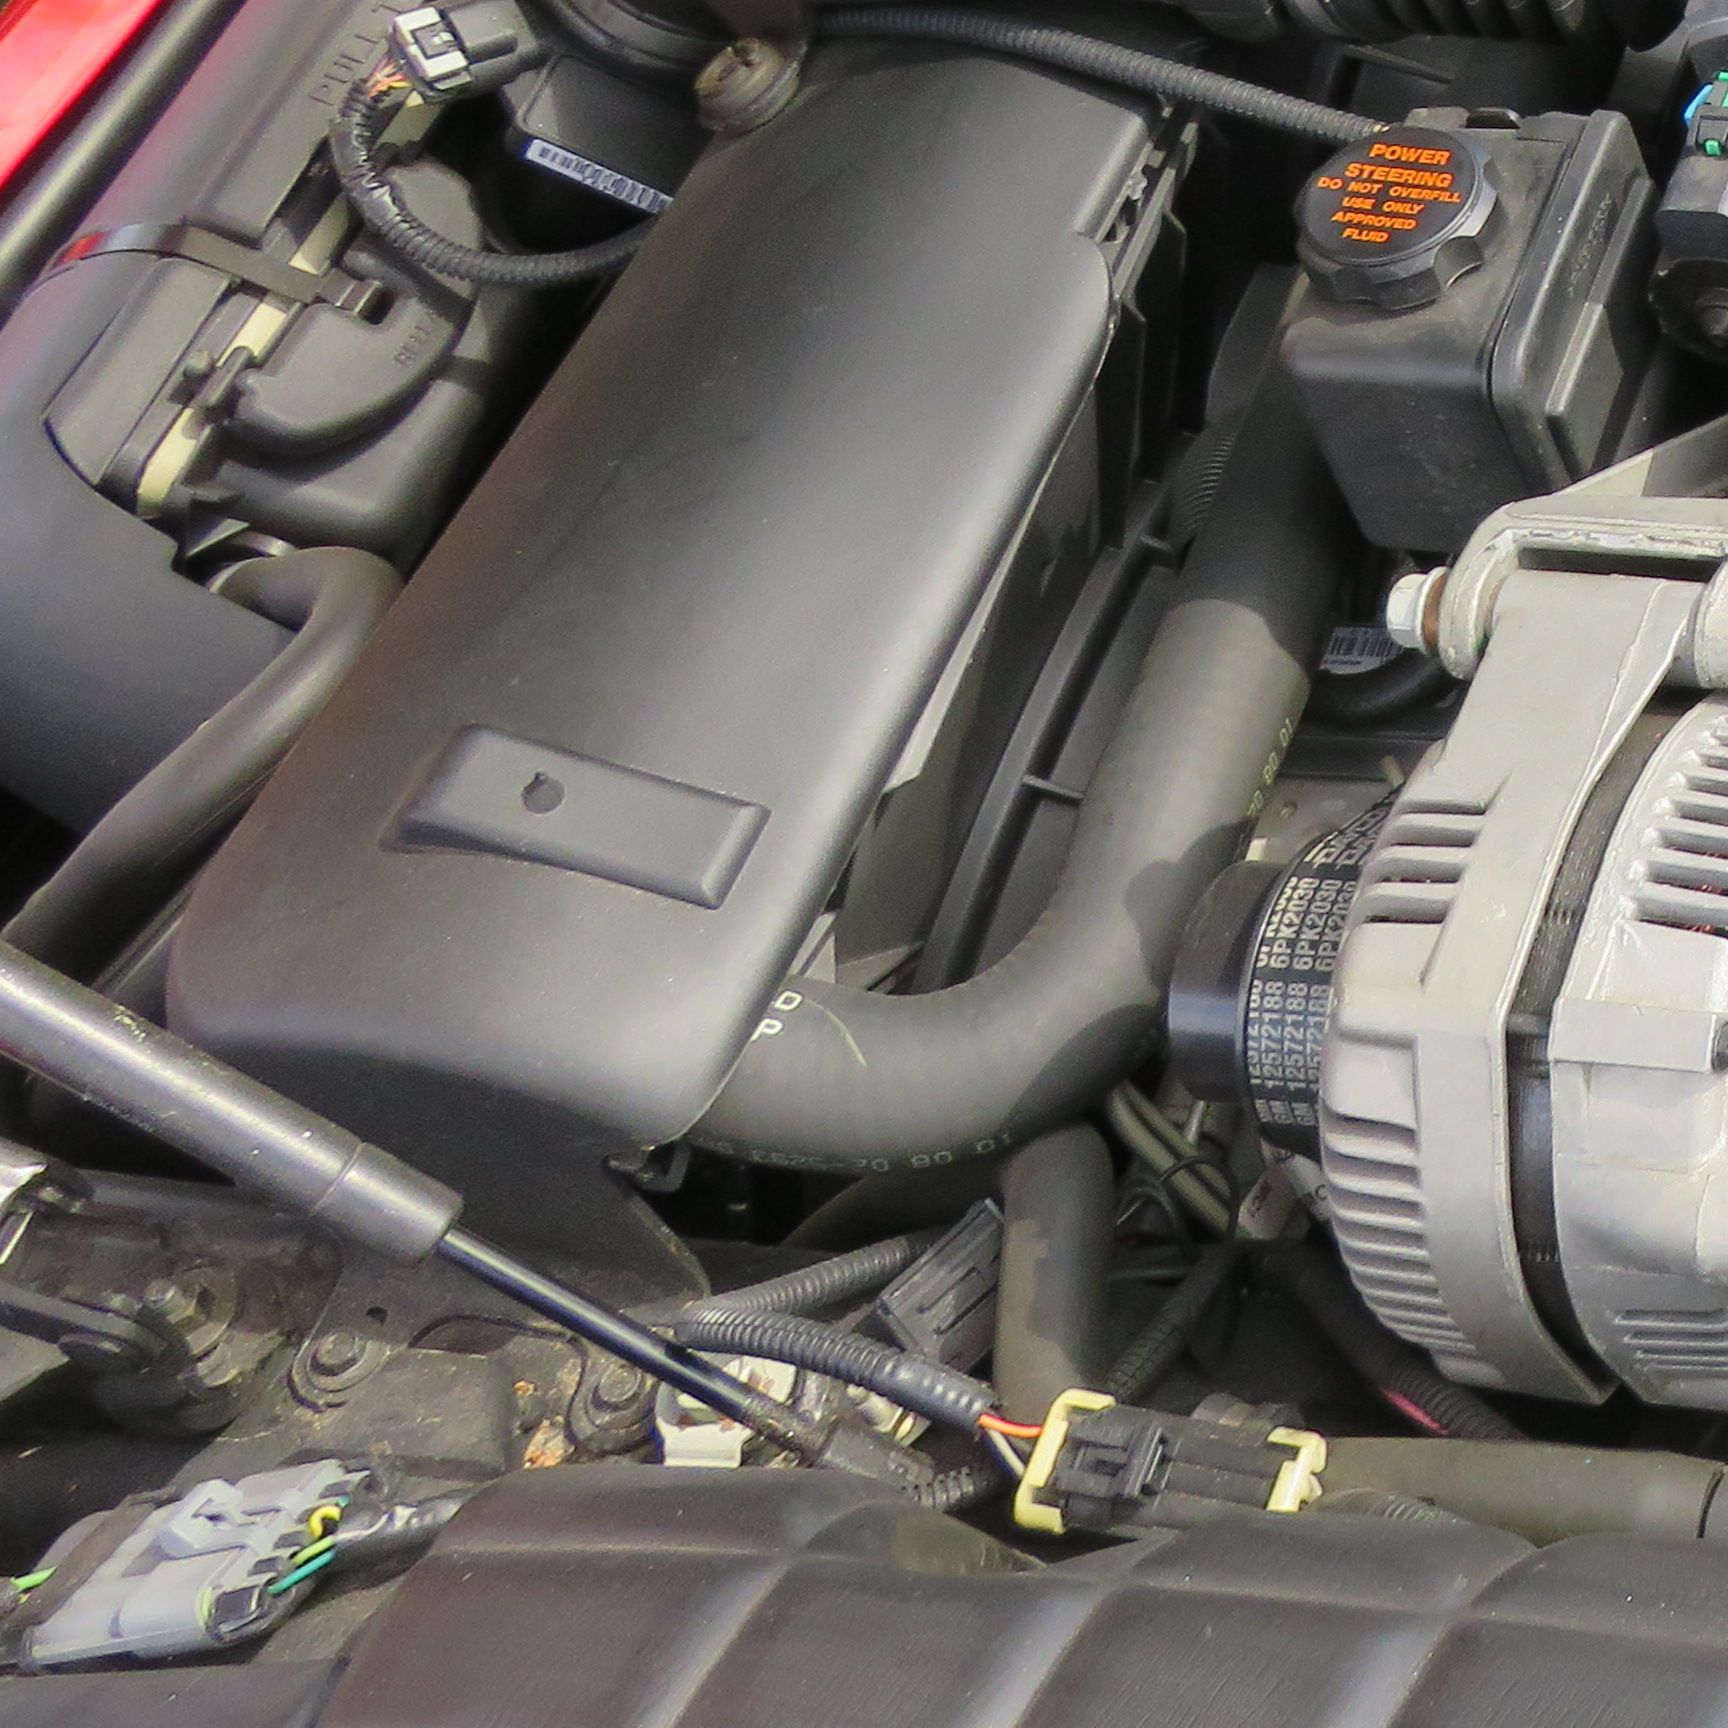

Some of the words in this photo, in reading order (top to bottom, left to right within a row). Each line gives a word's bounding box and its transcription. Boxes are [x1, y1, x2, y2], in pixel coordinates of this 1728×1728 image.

[309, 30, 380, 109] PULL
[1369, 142, 1451, 166] POWER
[1344, 161, 1453, 188] STEERING
[1316, 176, 1343, 191] DO
[1346, 180, 1382, 195] NOT
[1388, 185, 1463, 203] OVERFILL
[1341, 196, 1376, 210] USE
[1381, 200, 1425, 215] ONLY
[1330, 210, 1417, 230] APPROVED
[1341, 227, 1389, 243] FLUID
[1270, 876, 1321, 969] 6PK2030
[1293, 879, 1343, 970] 6PK2030
[1261, 980, 1286, 1088] 12572188
[1283, 980, 1309, 1091] 12572188
